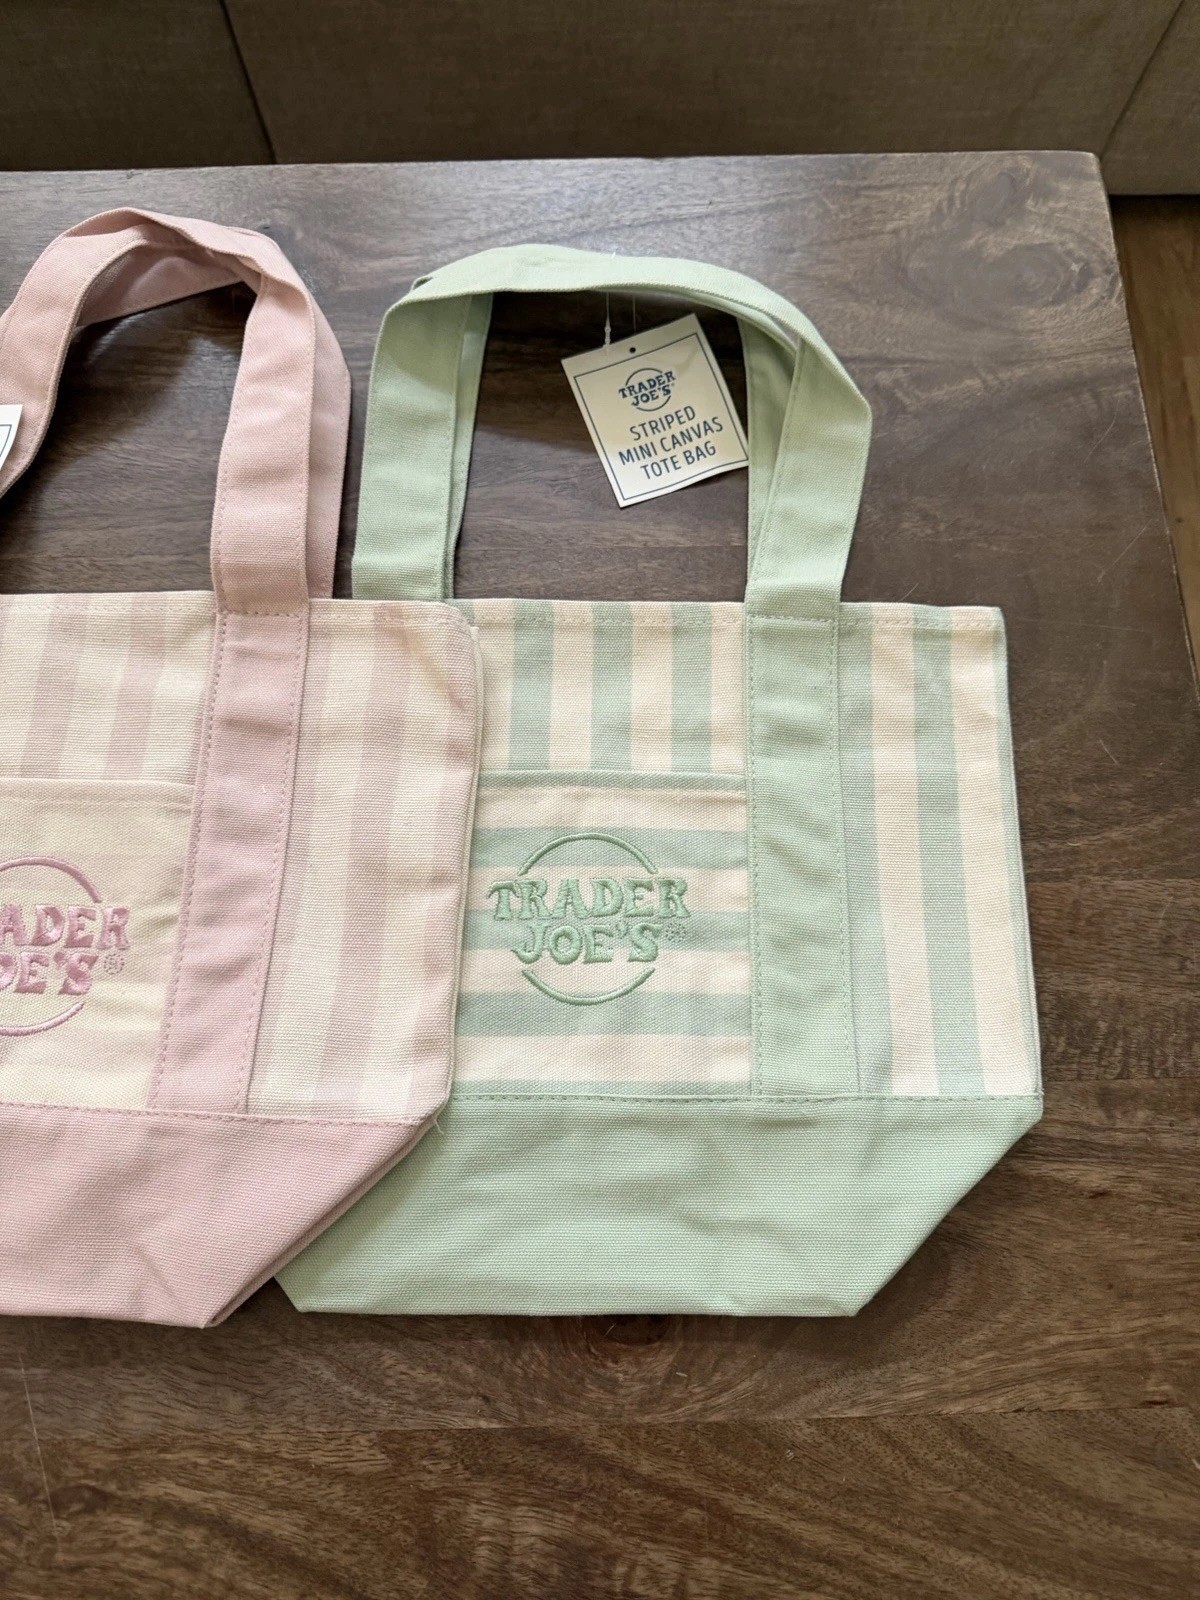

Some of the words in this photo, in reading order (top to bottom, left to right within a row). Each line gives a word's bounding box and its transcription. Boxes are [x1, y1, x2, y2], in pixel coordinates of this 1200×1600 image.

[619, 371, 676, 399] TRADER
[631, 385, 671, 406] JOE'S
[618, 442, 658, 466] MINI
[660, 417, 723, 452] CANVAS
[630, 406, 696, 441] STRIPED
[640, 455, 682, 480] TOTE
[683, 441, 717, 465] BAG
[486, 876, 691, 921] TRADER
